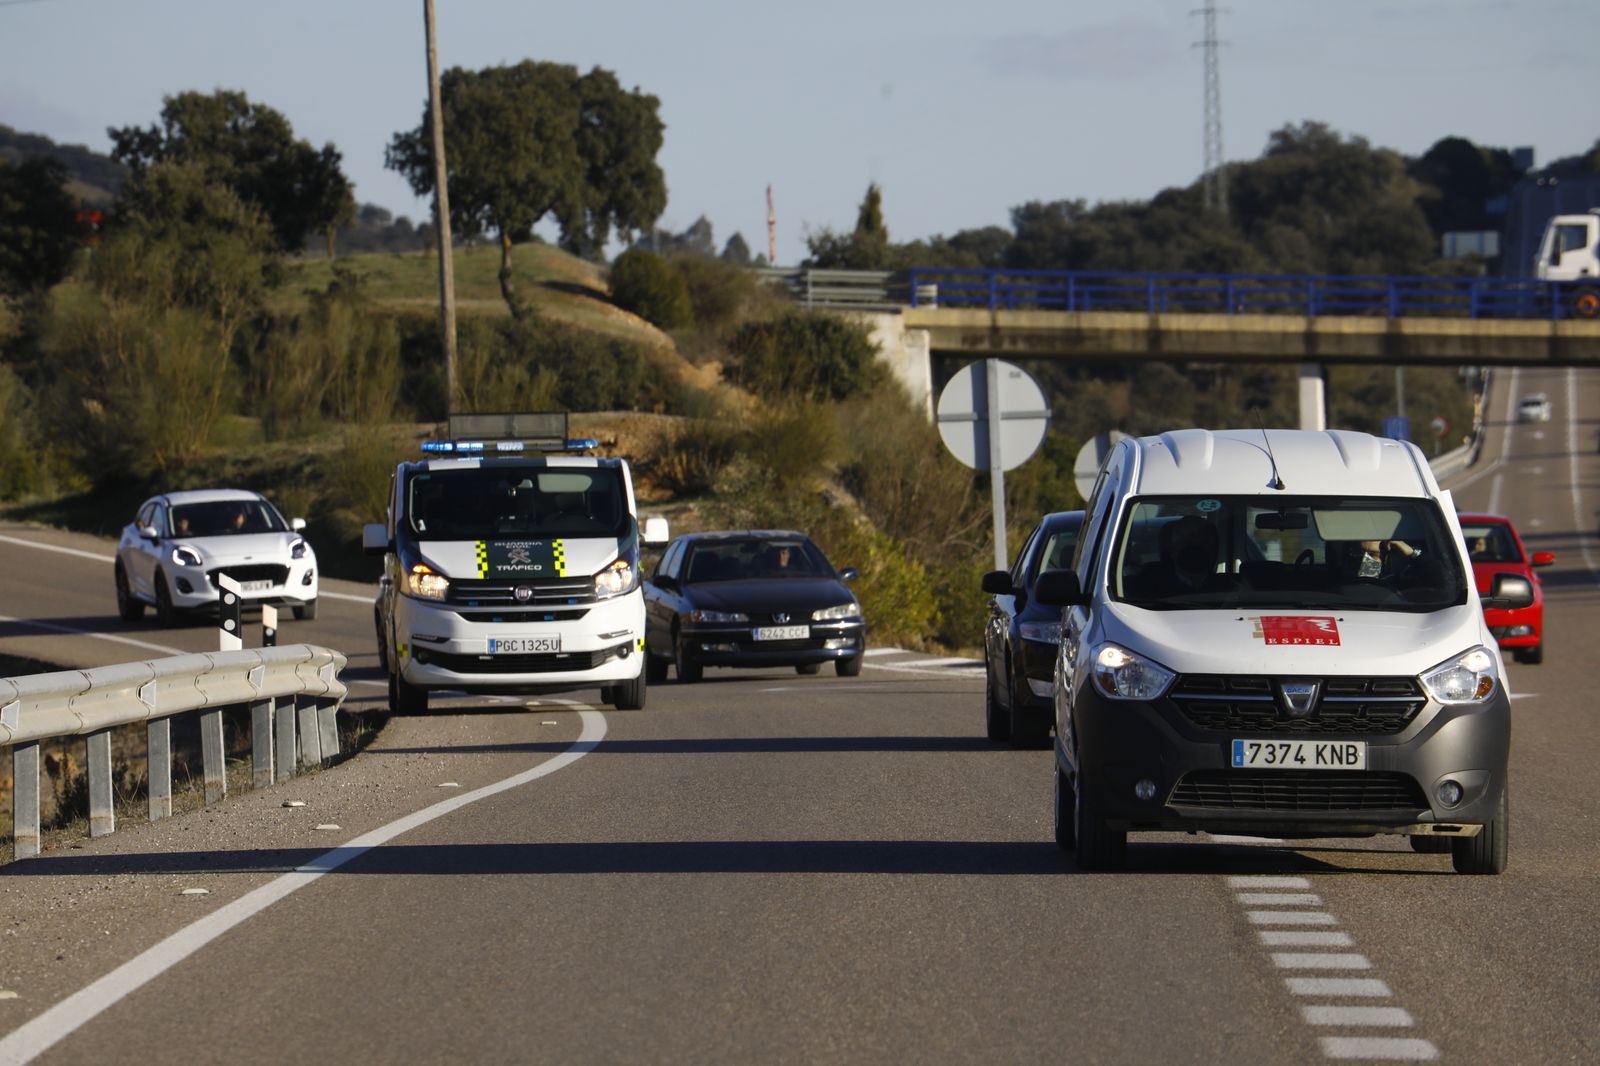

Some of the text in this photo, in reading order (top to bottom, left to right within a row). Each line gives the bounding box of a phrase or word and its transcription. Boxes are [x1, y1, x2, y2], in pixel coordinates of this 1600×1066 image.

[760, 628, 785, 640] 6242
[495, 639, 518, 652] PGC
[1249, 743, 1306, 765] 7374
[1315, 744, 1359, 765] KNB
